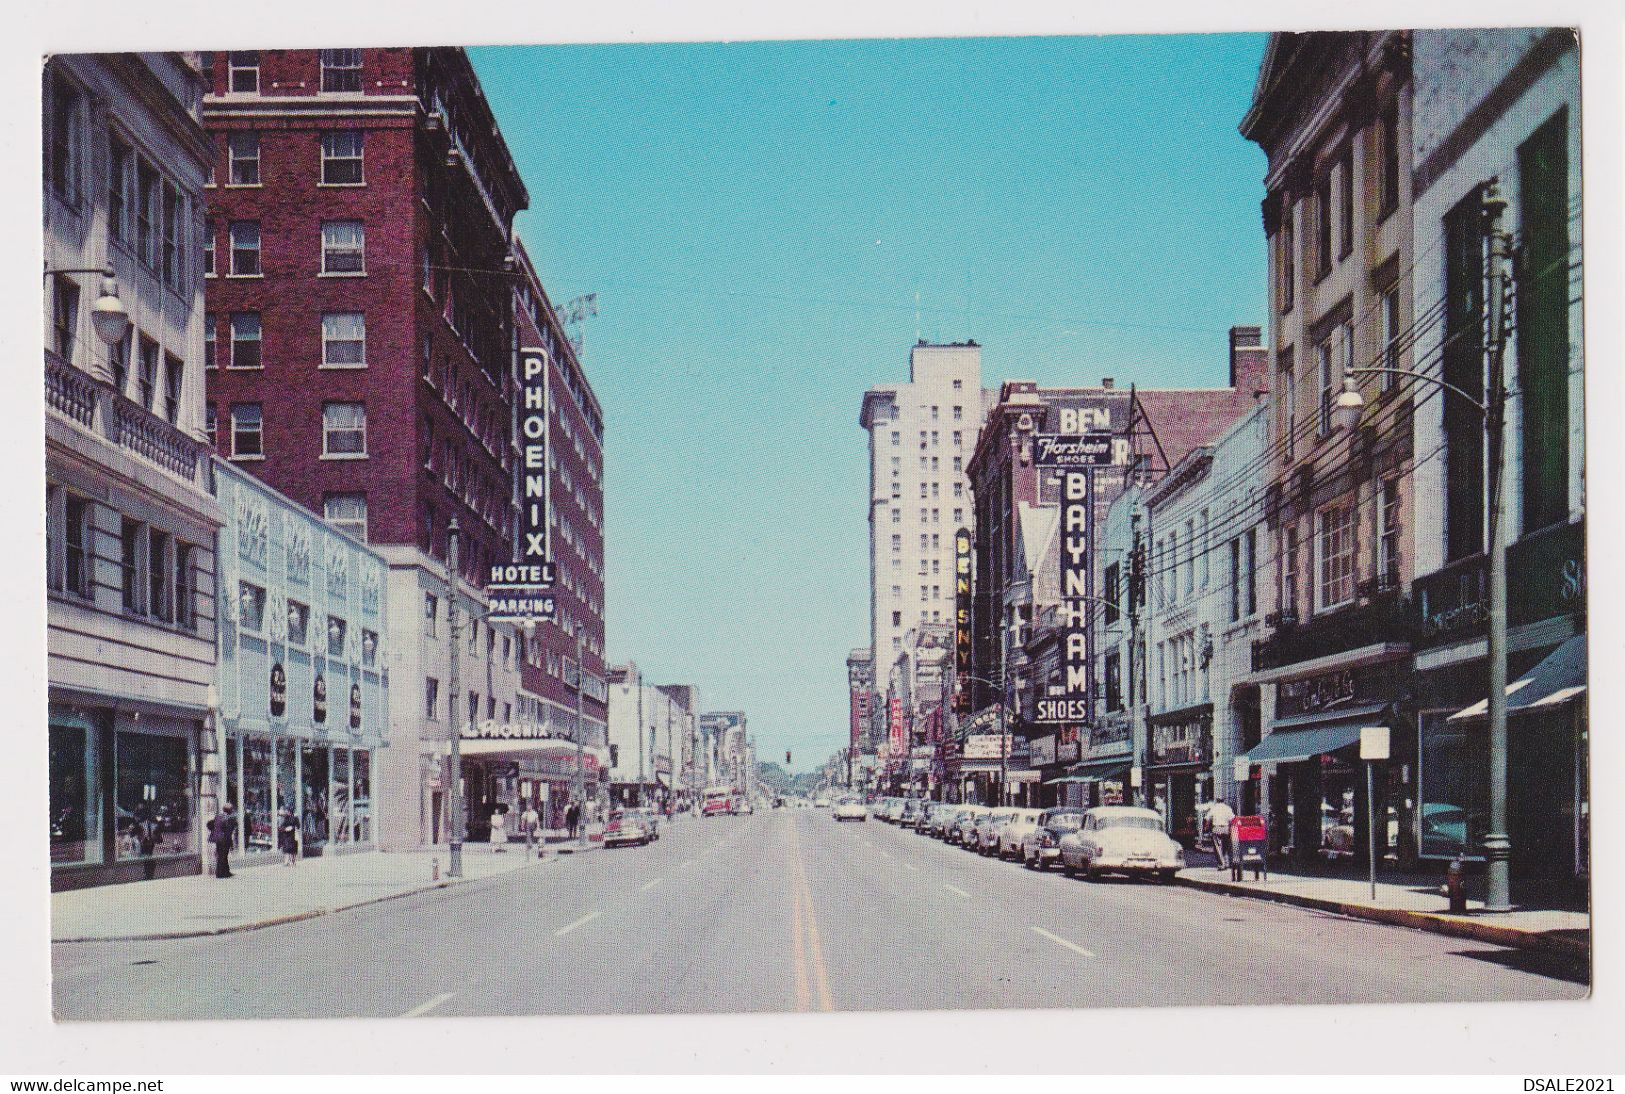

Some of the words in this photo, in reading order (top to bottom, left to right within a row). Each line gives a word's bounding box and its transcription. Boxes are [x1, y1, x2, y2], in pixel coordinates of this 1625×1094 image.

[1060, 408, 1111, 435] BEN
[523, 357, 545, 556] PHOENIX
[1037, 436, 1109, 461] Florsheim
[1056, 455, 1095, 463] SHOES
[491, 566, 553, 582] HOTEL
[956, 537, 970, 594] BEN
[1066, 473, 1086, 693] BAYNHAM
[489, 599, 554, 614] PARKING
[1037, 700, 1086, 720] SHOES
